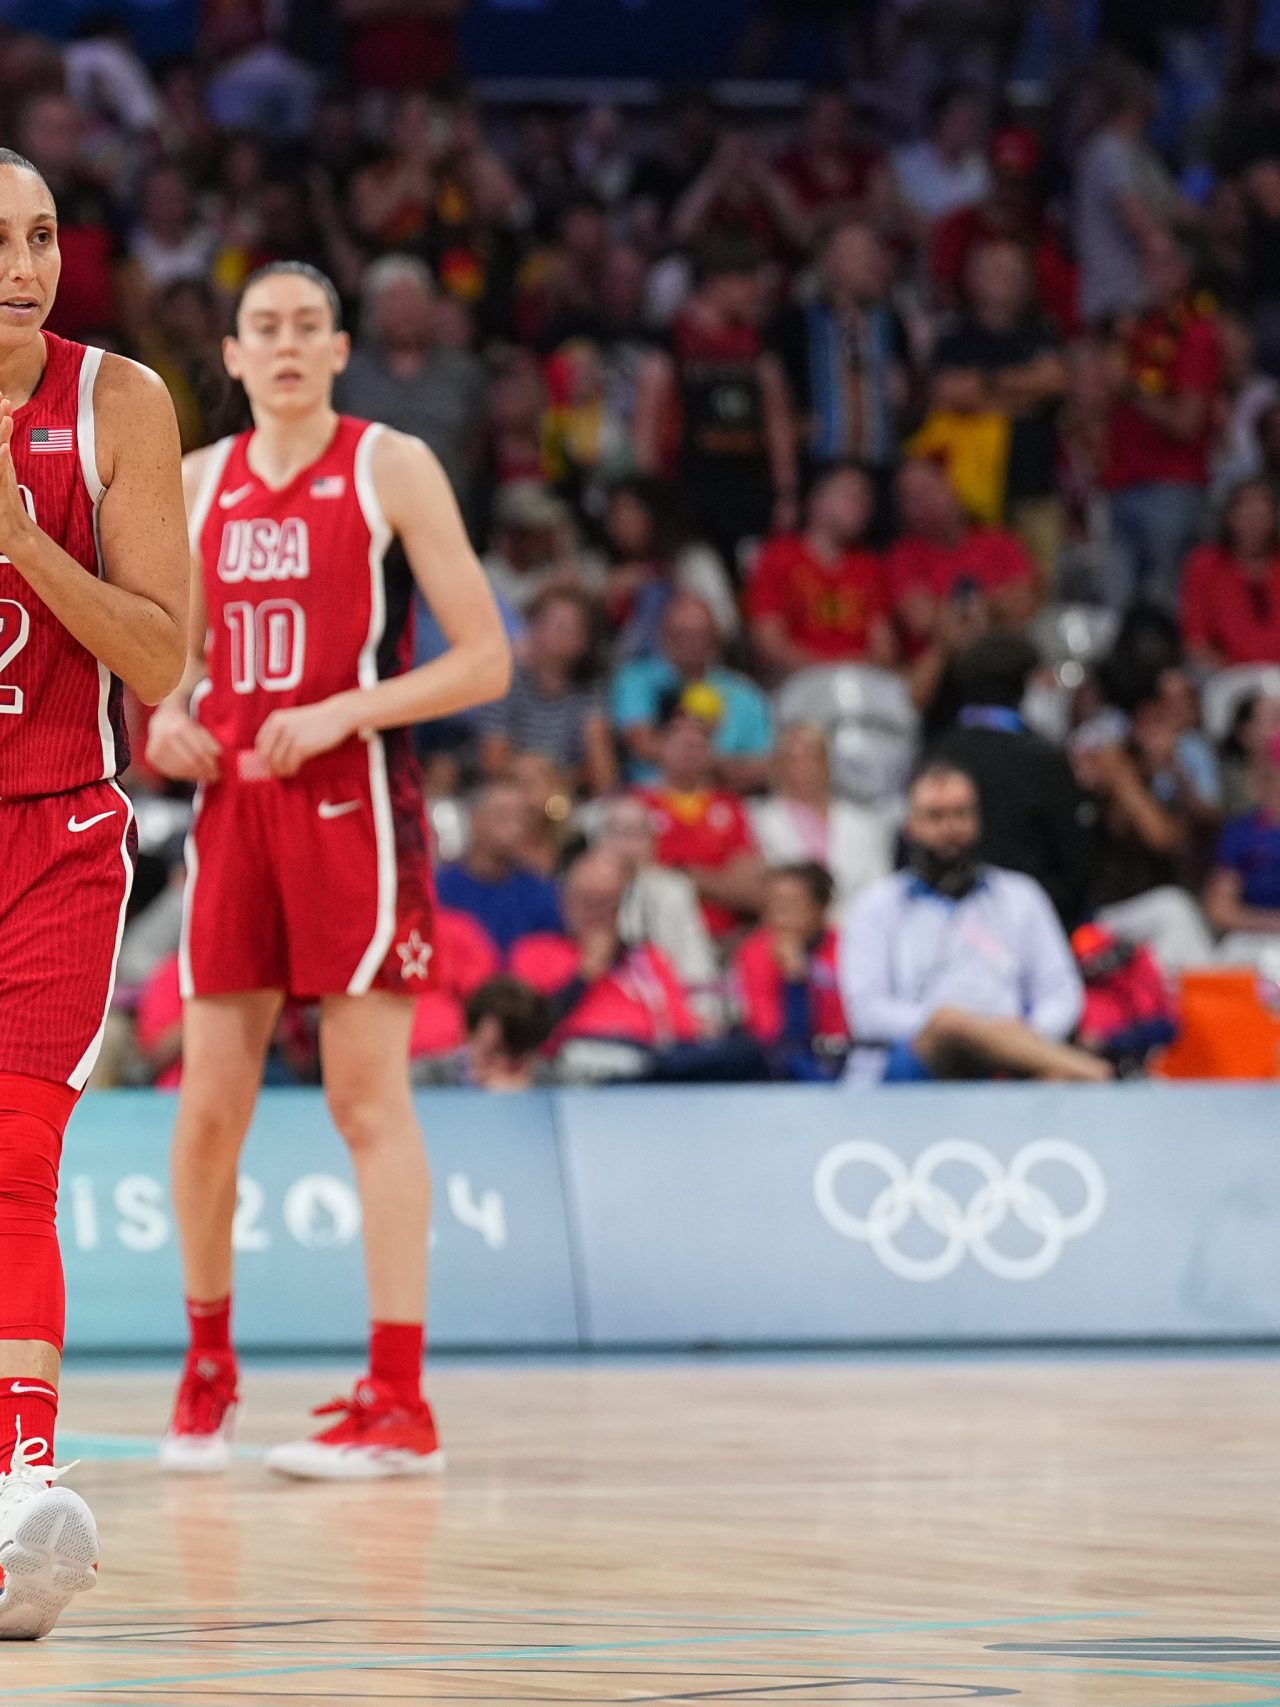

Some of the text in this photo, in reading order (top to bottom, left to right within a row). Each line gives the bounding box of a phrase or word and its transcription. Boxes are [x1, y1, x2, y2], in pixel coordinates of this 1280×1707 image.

[217, 517, 310, 583] USA
[223, 598, 306, 695] 10
[232, 1173, 507, 1251] 204
